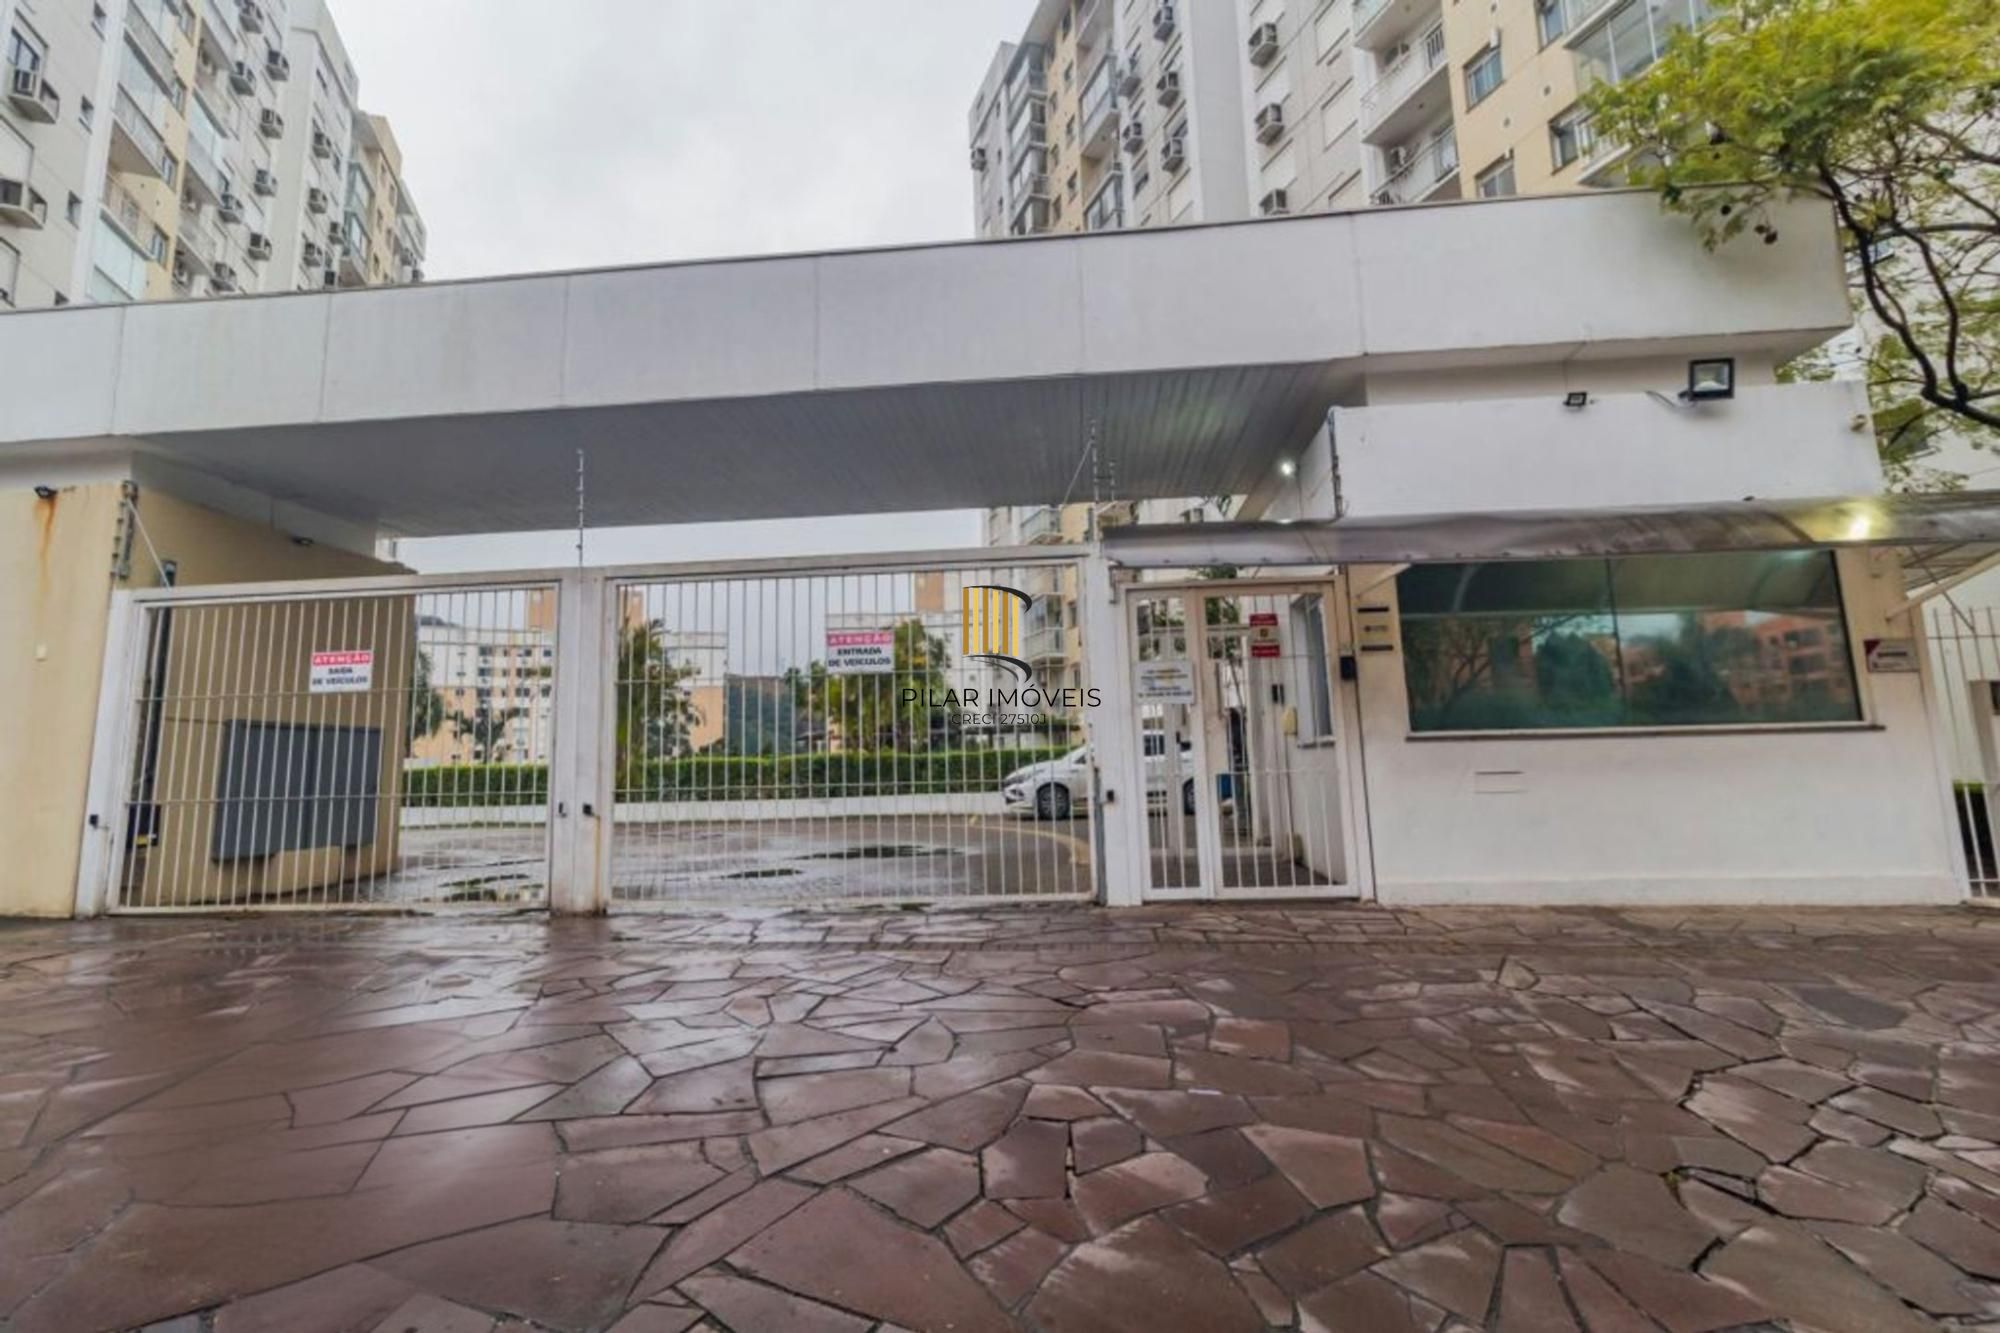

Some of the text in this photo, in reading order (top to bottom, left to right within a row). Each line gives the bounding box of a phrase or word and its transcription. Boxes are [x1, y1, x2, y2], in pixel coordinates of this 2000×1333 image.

[829, 633, 890, 644] ATENÇÃO
[837, 647, 882, 655] ENTRADA
[314, 654, 369, 665] ATENÇÃO
[828, 659, 840, 667] DE
